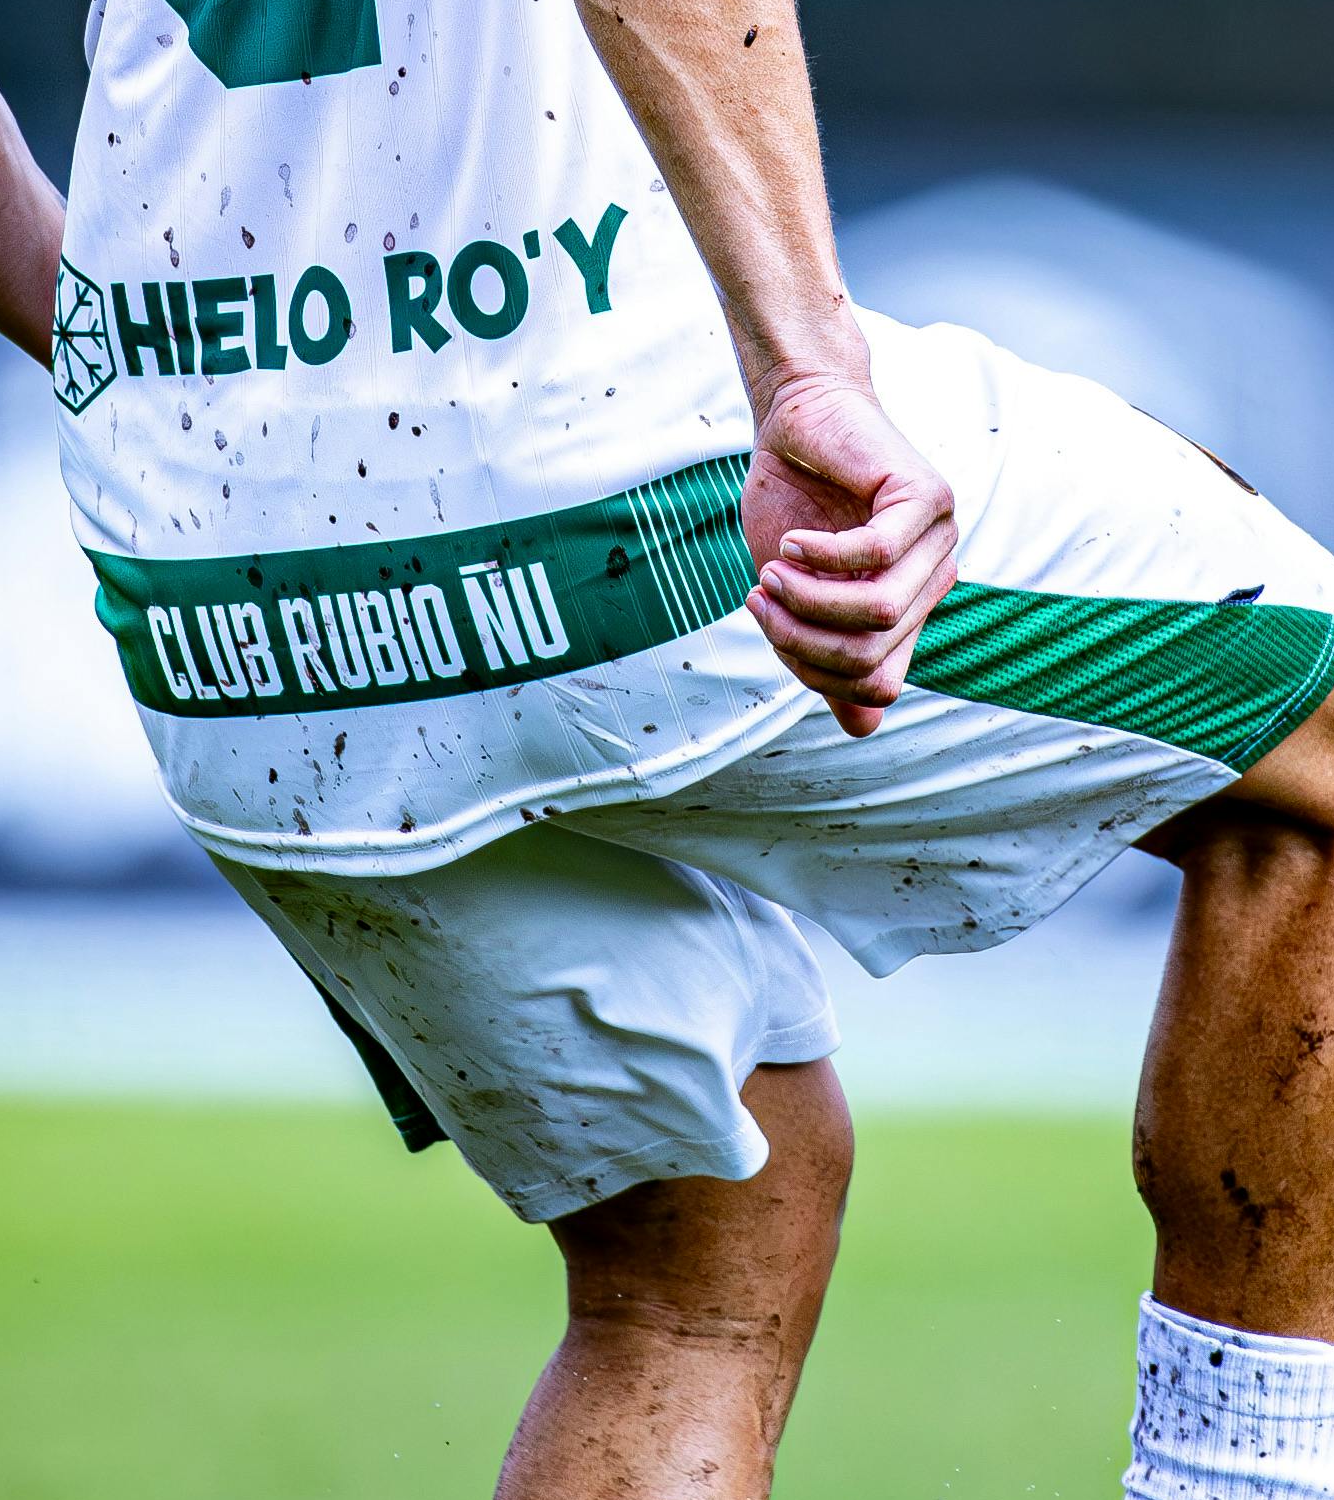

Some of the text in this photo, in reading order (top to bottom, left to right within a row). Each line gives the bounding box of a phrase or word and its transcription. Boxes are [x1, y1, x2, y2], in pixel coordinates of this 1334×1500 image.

[111, 203, 629, 377] HIELO RO'Y
[146, 560, 570, 701] CLUB RUBIO ÑU
